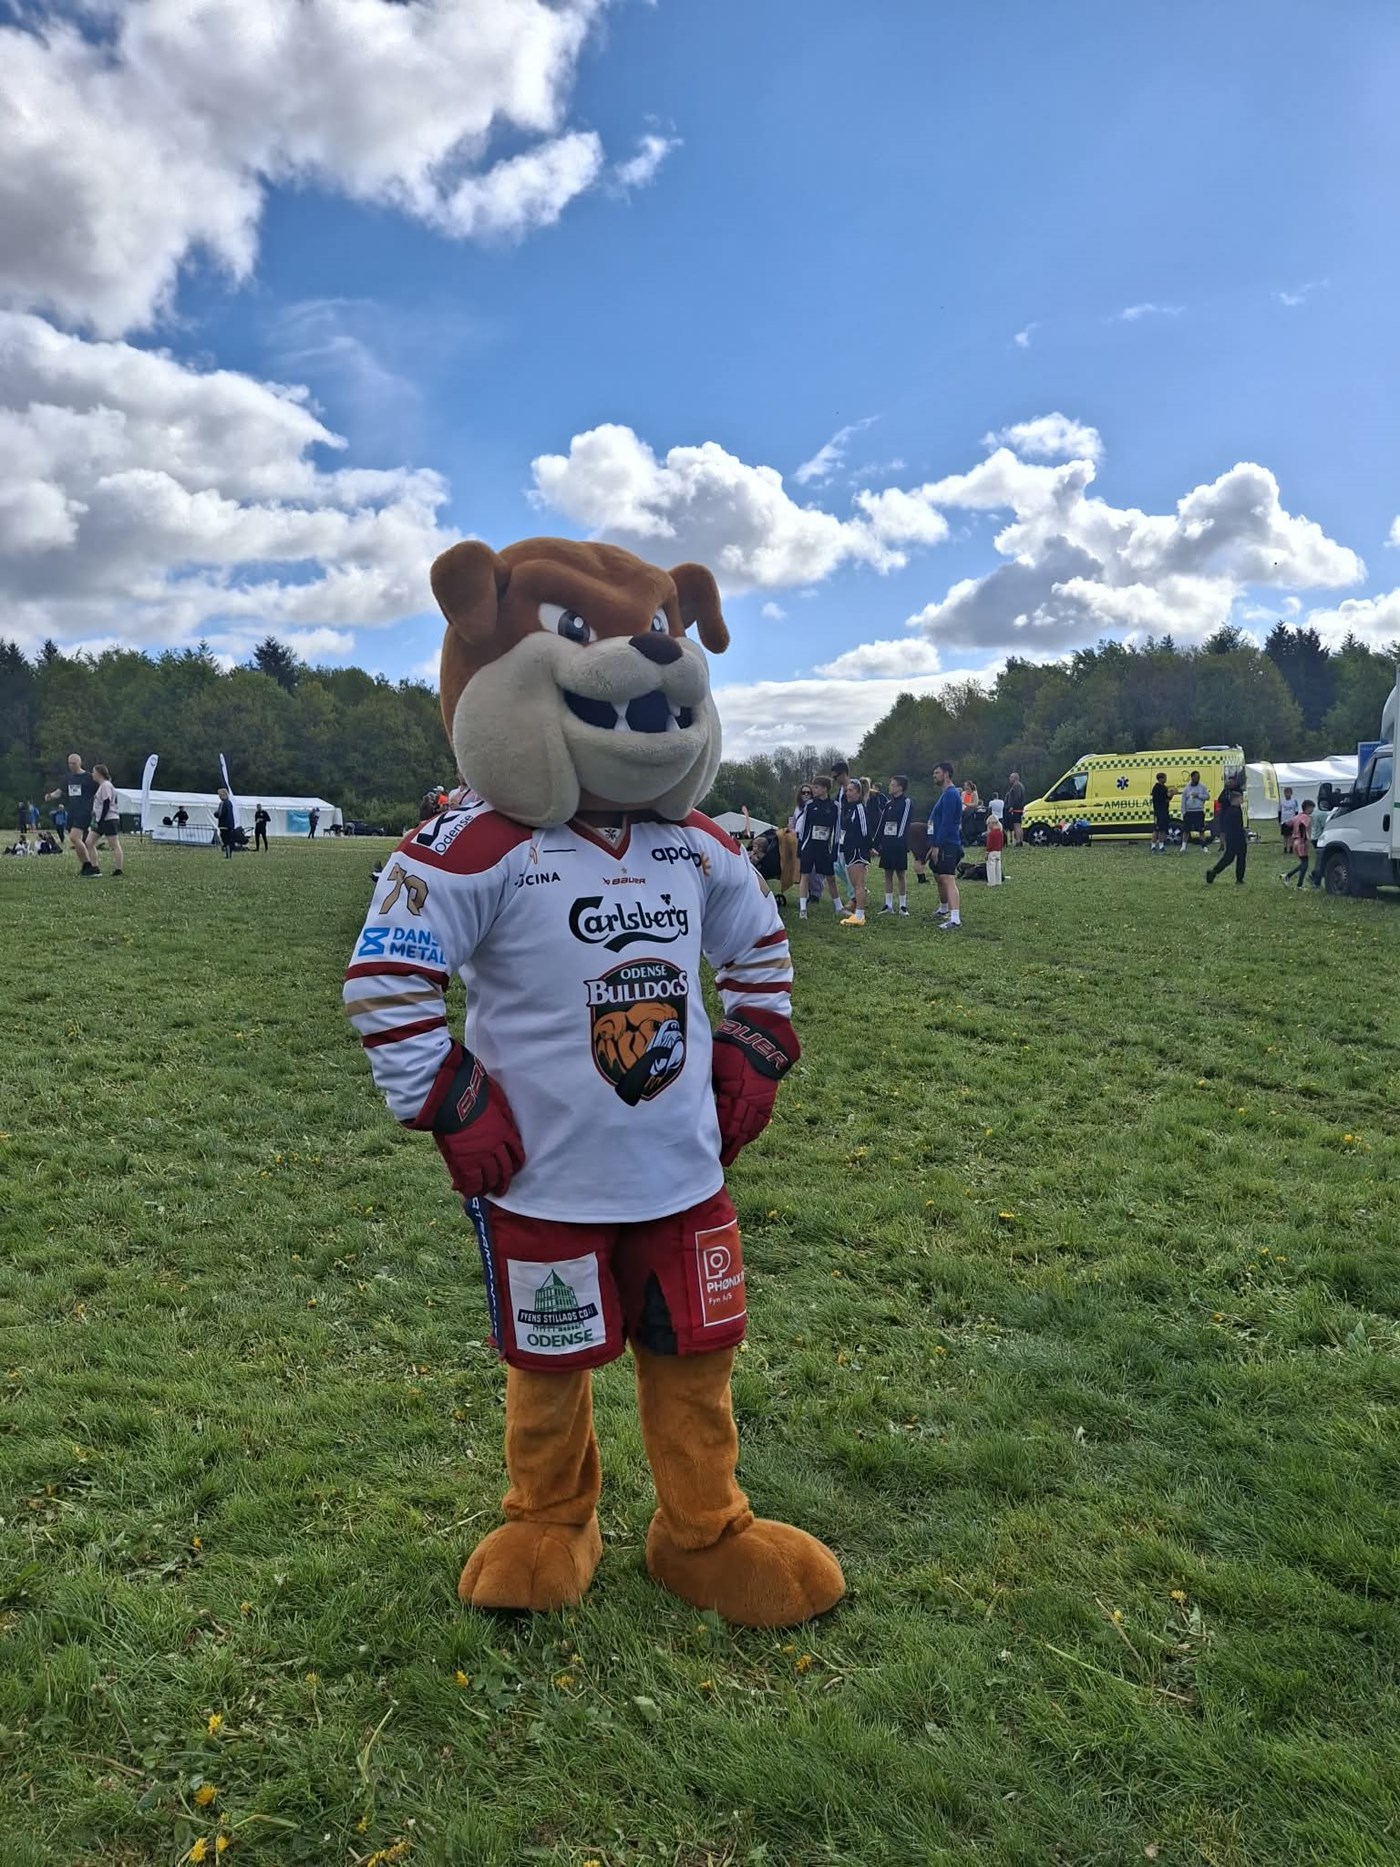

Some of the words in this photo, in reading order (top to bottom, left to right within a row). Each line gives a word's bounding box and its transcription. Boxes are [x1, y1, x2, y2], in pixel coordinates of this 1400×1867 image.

[434, 814, 475, 853] Odense
[568, 896, 689, 953] Carlsberg
[388, 942, 447, 965] METAL
[585, 971, 689, 1005] BULLDOGS
[620, 965, 668, 980] ODENSE
[714, 1018, 789, 1071] AUER
[526, 1328, 595, 1347] ODENSE
